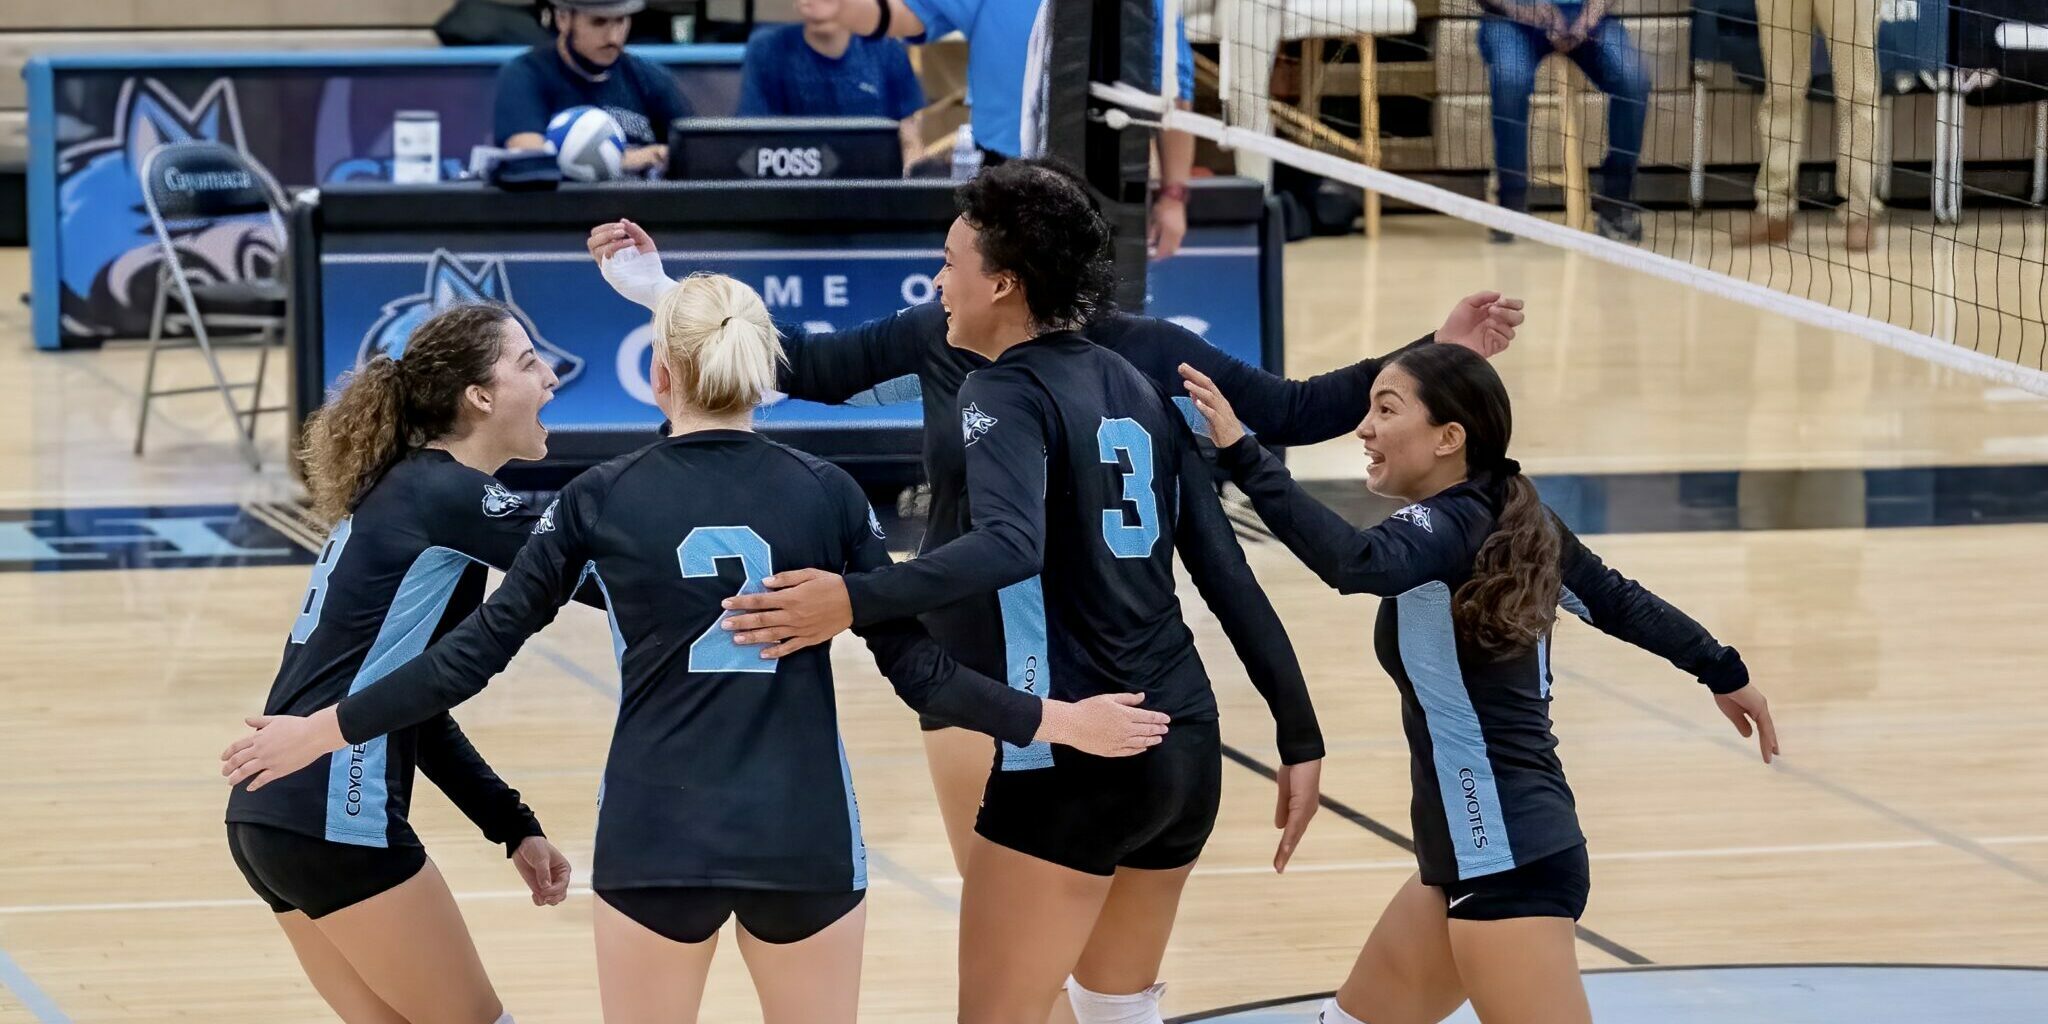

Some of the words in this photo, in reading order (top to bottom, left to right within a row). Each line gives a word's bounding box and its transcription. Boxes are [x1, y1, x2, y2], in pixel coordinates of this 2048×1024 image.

[757, 147, 823, 177] POSS
[763, 274, 849, 307] ME
[1097, 416, 1160, 558] 3
[676, 525, 779, 673] 2
[345, 742, 367, 817] COYOTE
[1458, 766, 1489, 849] COYOTES
